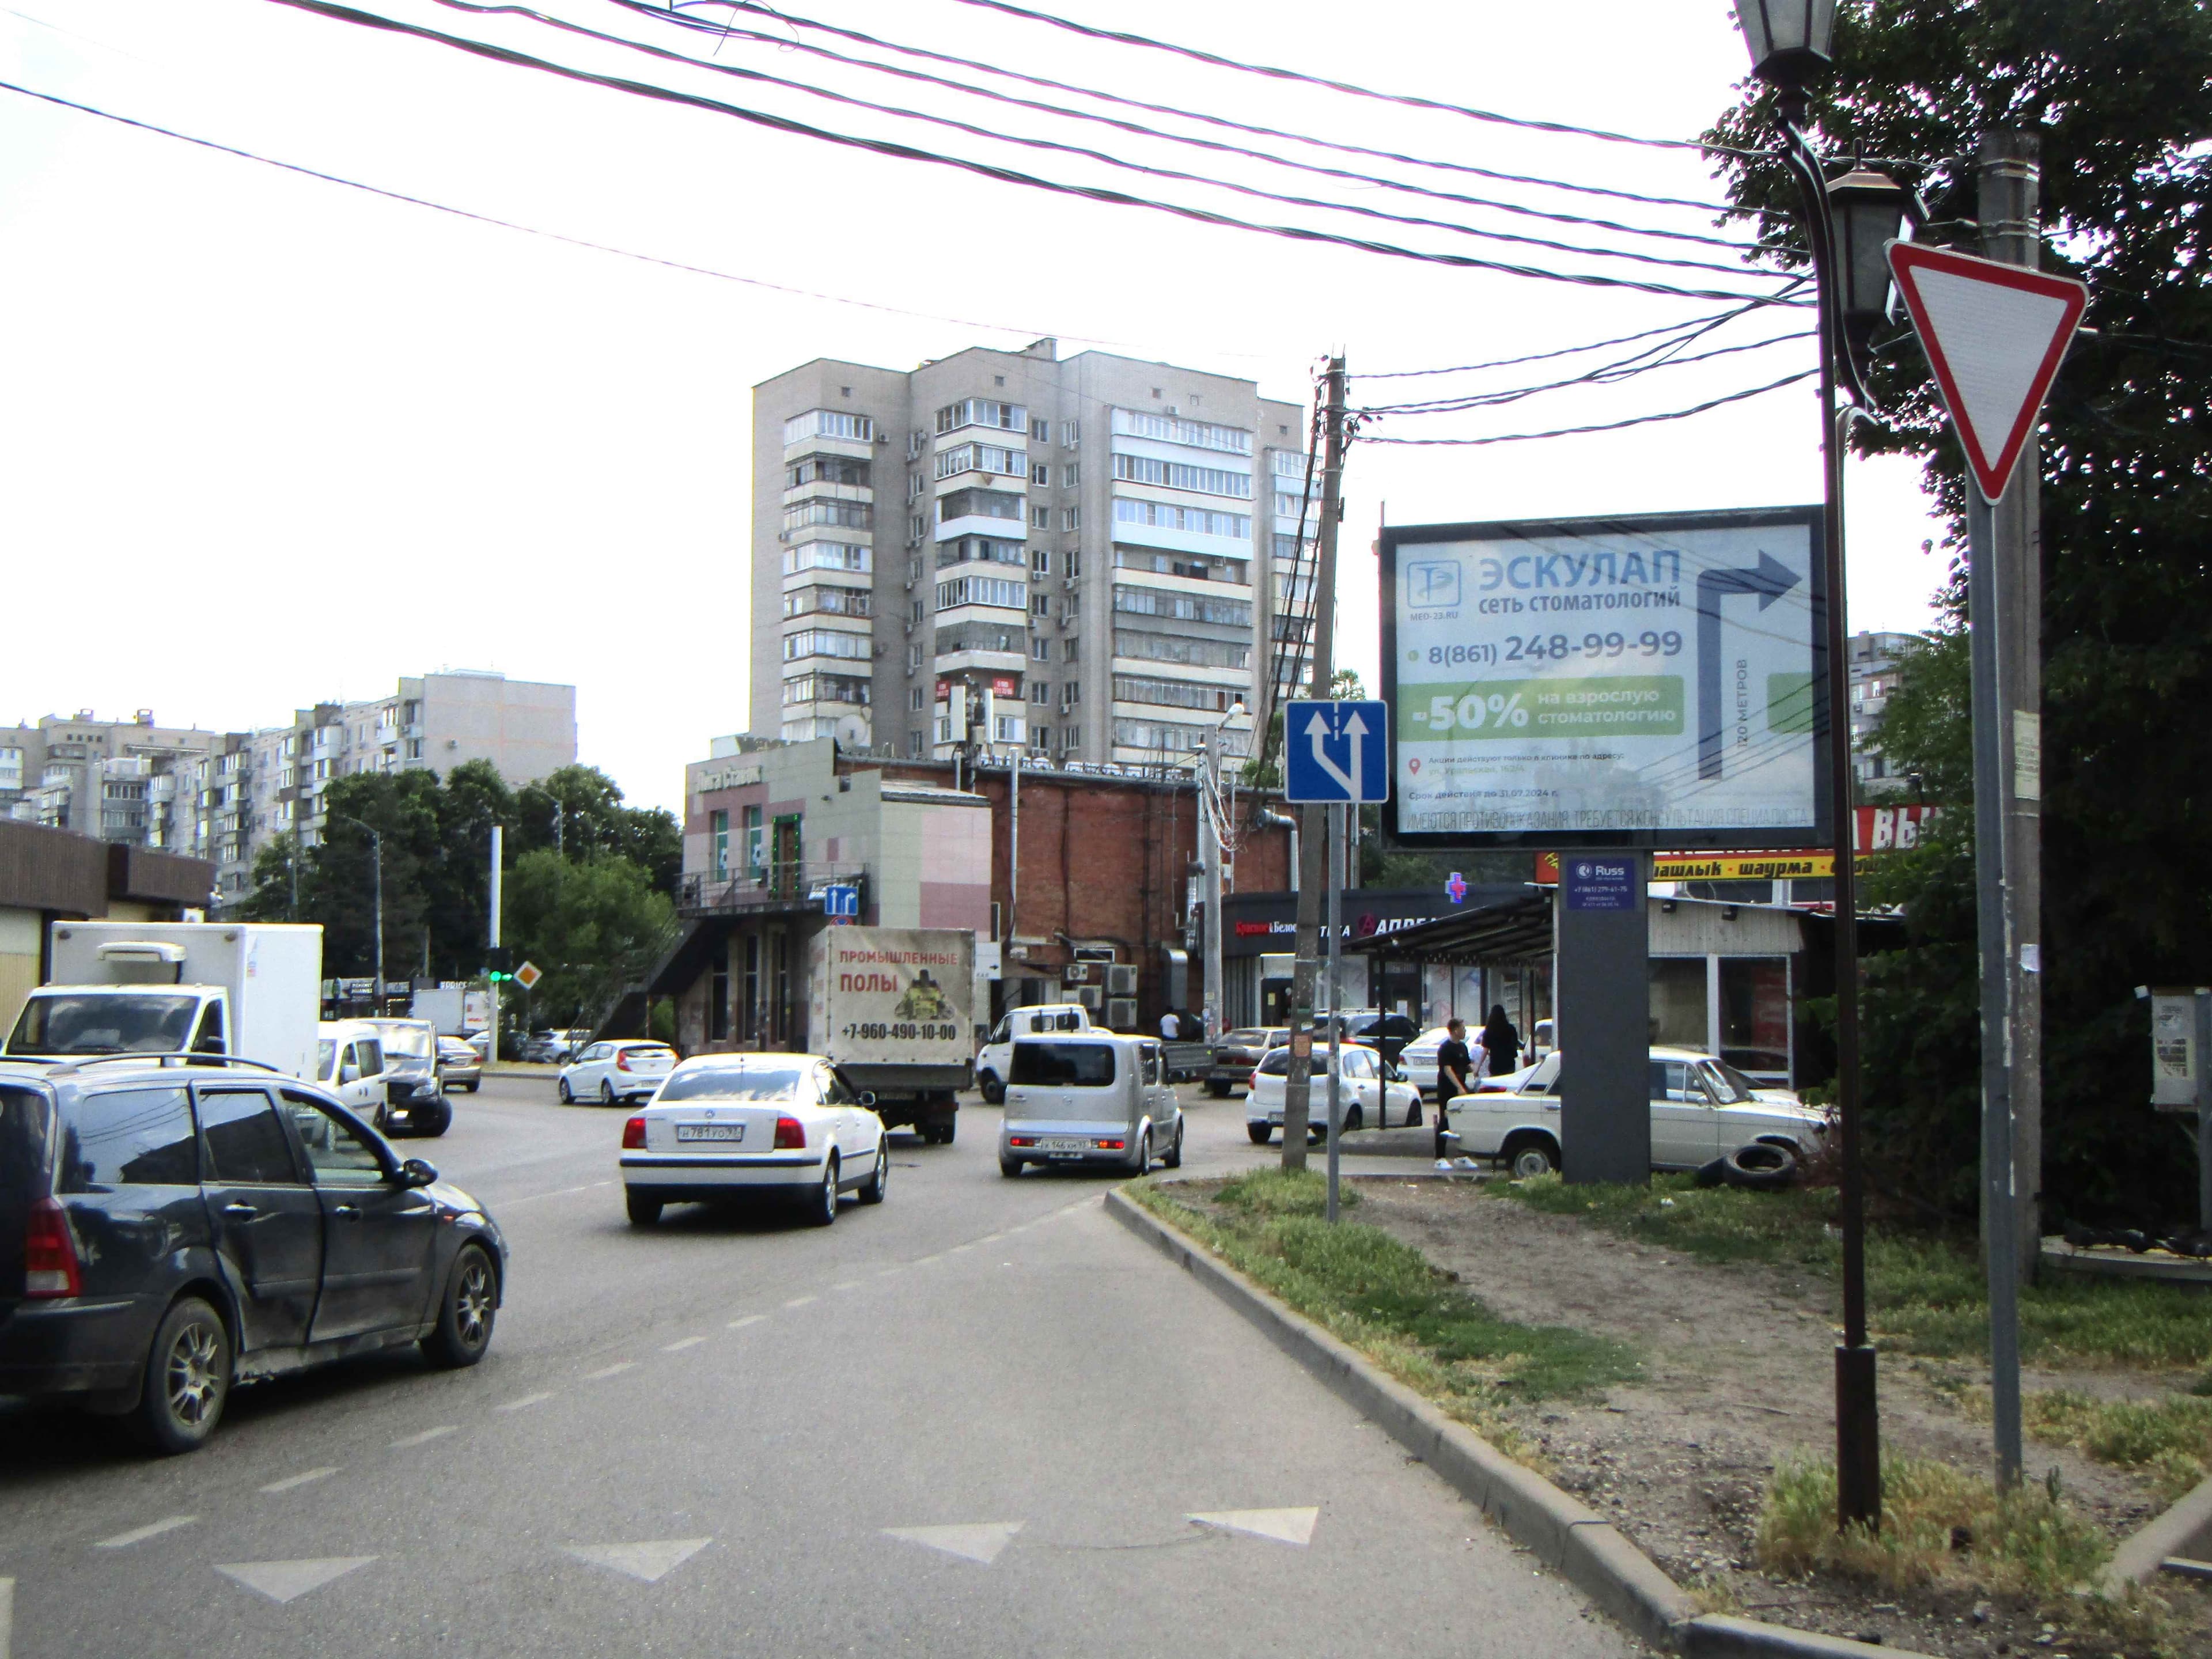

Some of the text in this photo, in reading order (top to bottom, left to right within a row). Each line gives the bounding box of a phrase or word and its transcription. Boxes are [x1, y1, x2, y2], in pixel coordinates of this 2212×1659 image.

[1479, 550, 1680, 591] ЭСКУЛАП
[1479, 586, 1680, 615] сеть стоматологий
[1410, 611, 1458, 622] MED-23.RU
[1429, 631, 1682, 666] 8(861) 248-99-99
[1538, 690, 1660, 707] на взрослую
[1736, 659, 1747, 721] МЕТРОВ
[1412, 692, 1529, 730] -50%
[1538, 710, 1676, 725] стоматологию
[1408, 792, 1433, 801] Срок
[1435, 790, 1482, 800] действия
[1484, 791, 1497, 799] до
[1407, 811, 1456, 830] ИМЕЮТСЯ
[1575, 809, 1634, 828] ТРЕБУЕТСЯ
[1596, 865, 1624, 876] Russ
[1738, 861, 1813, 878] шаурма
[839, 950, 958, 965] ПРОМЫШЛЕННЫЕ
[840, 974, 898, 993] ПОЛЫ
[842, 1023, 956, 1040] +7-960-490-10-00
